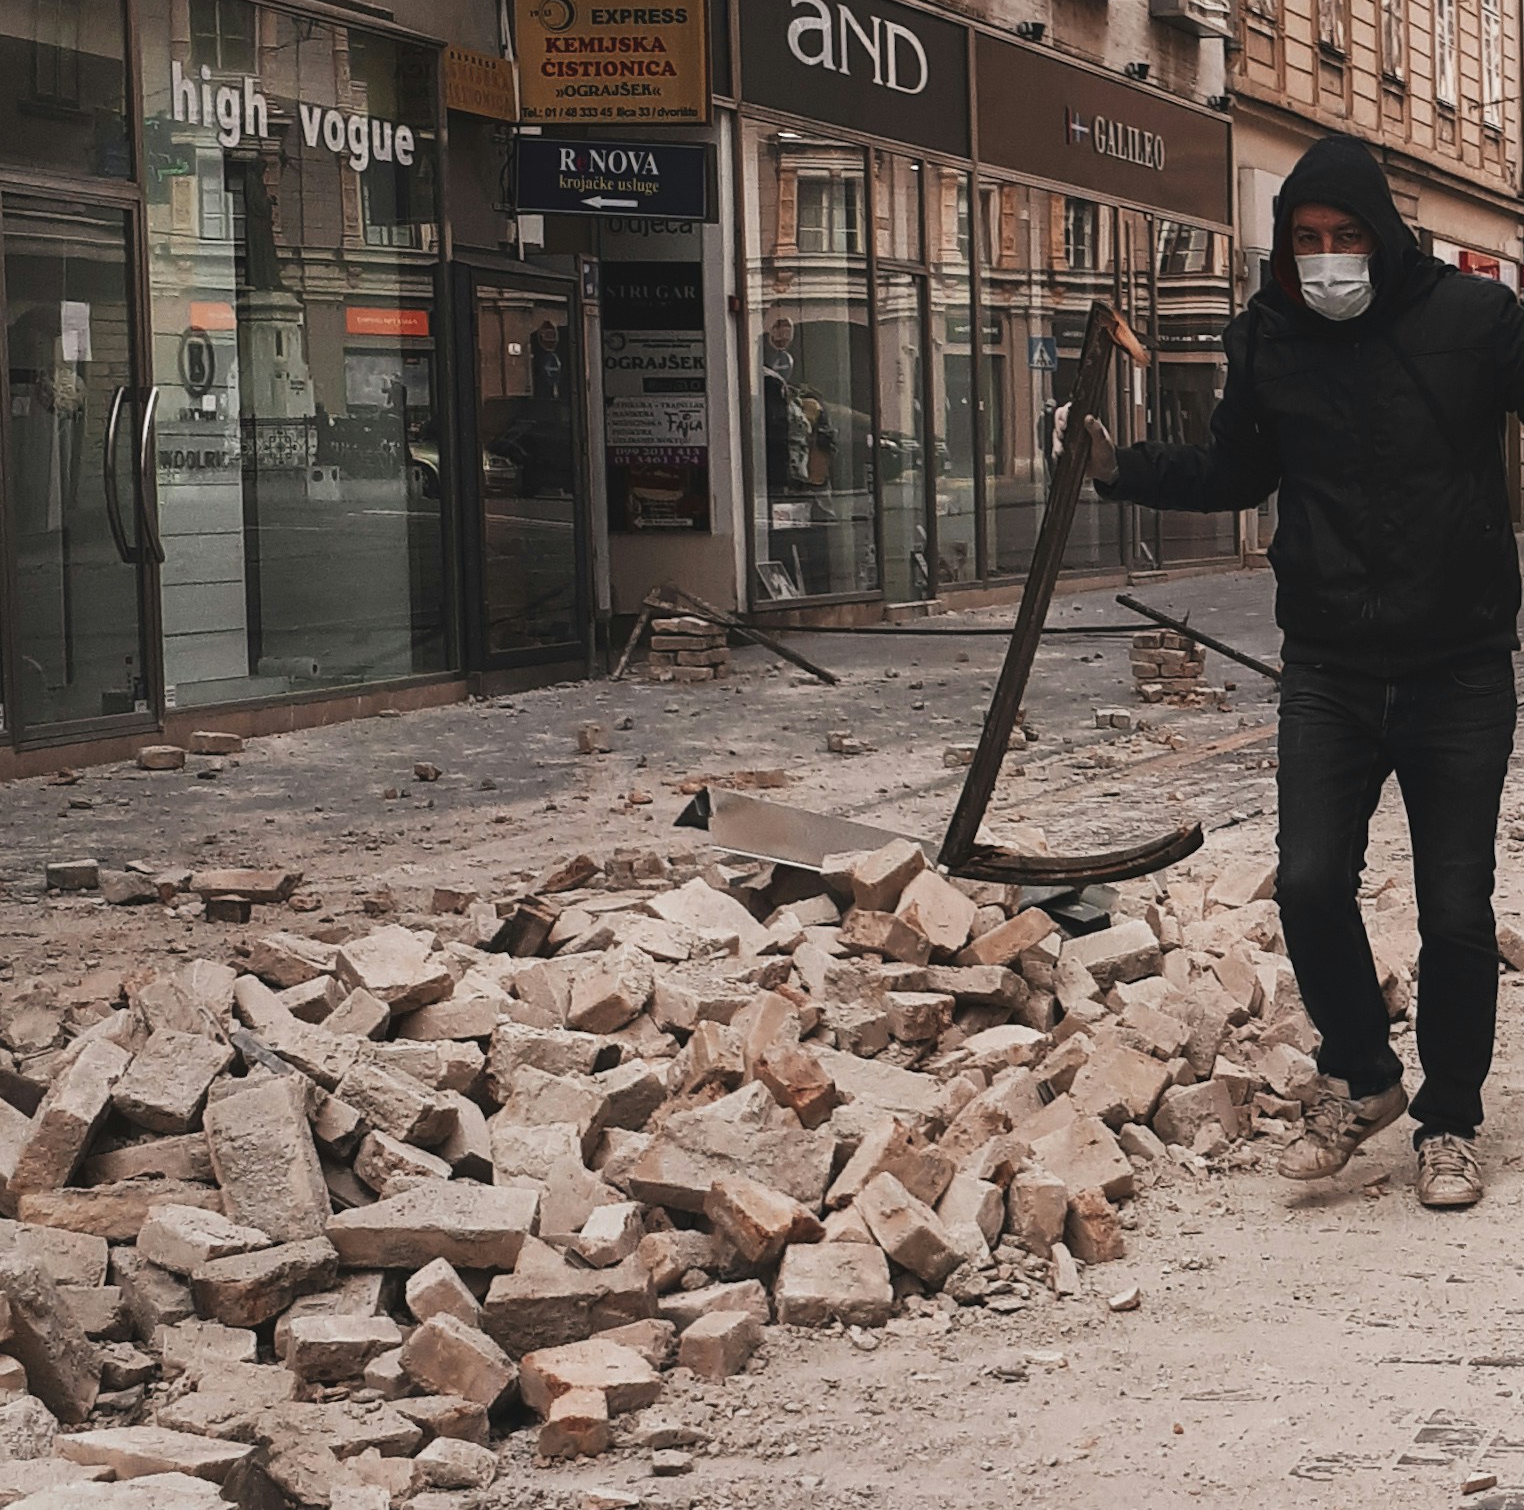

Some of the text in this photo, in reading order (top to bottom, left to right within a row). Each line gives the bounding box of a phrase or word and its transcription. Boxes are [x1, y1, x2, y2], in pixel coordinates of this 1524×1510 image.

[591, 8, 688, 25] EXPRESS
[544, 36, 667, 54] KEMIJSKA
[540, 57, 678, 78] ČISTIONICA
[170, 59, 270, 149] high
[300, 99, 417, 173] vogue
[1092, 114, 1166, 172] GALILEO
[559, 174, 660, 196] krojačke usluge
[605, 354, 705, 371] OGRAJŠEK
